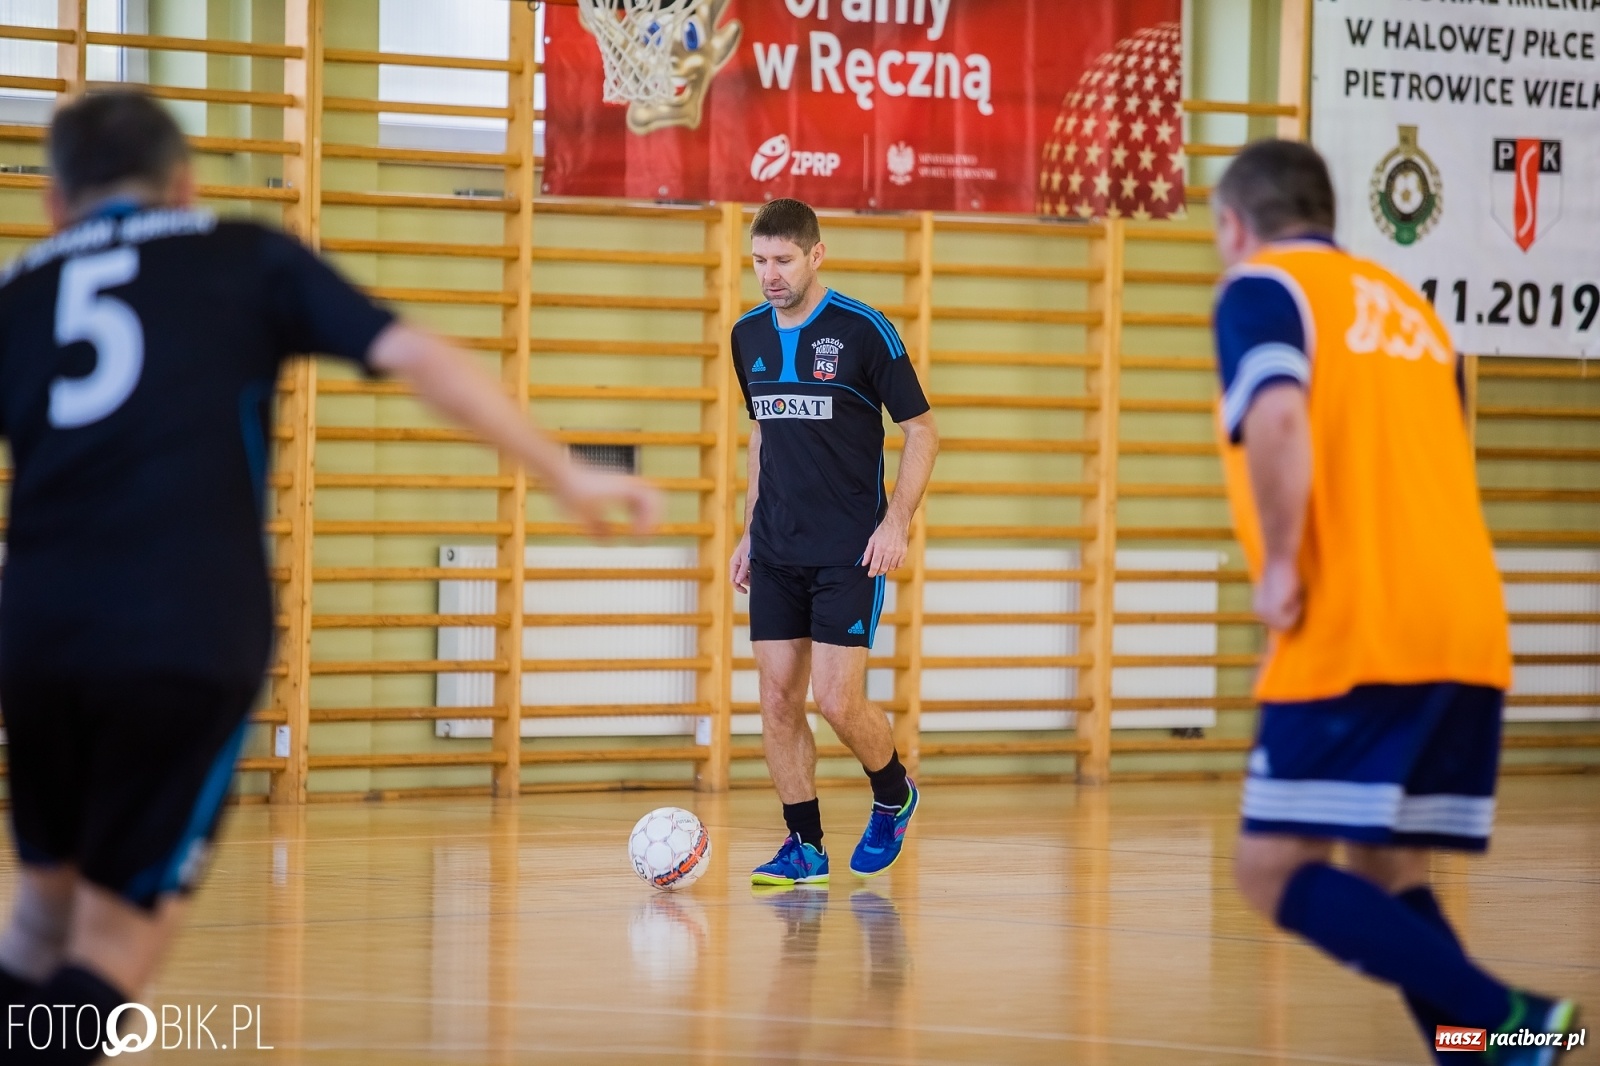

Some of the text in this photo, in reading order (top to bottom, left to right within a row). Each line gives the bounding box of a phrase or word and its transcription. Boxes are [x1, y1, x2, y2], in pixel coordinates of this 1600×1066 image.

[1346, 17, 1595, 62] W HALOWEJ PIŁCE
[752, 30, 994, 116] w Ręczną
[1344, 69, 1514, 106] PIETROWICE
[790, 151, 841, 177] ZPRP
[47, 247, 145, 429] 5
[816, 360, 835, 373] KS
